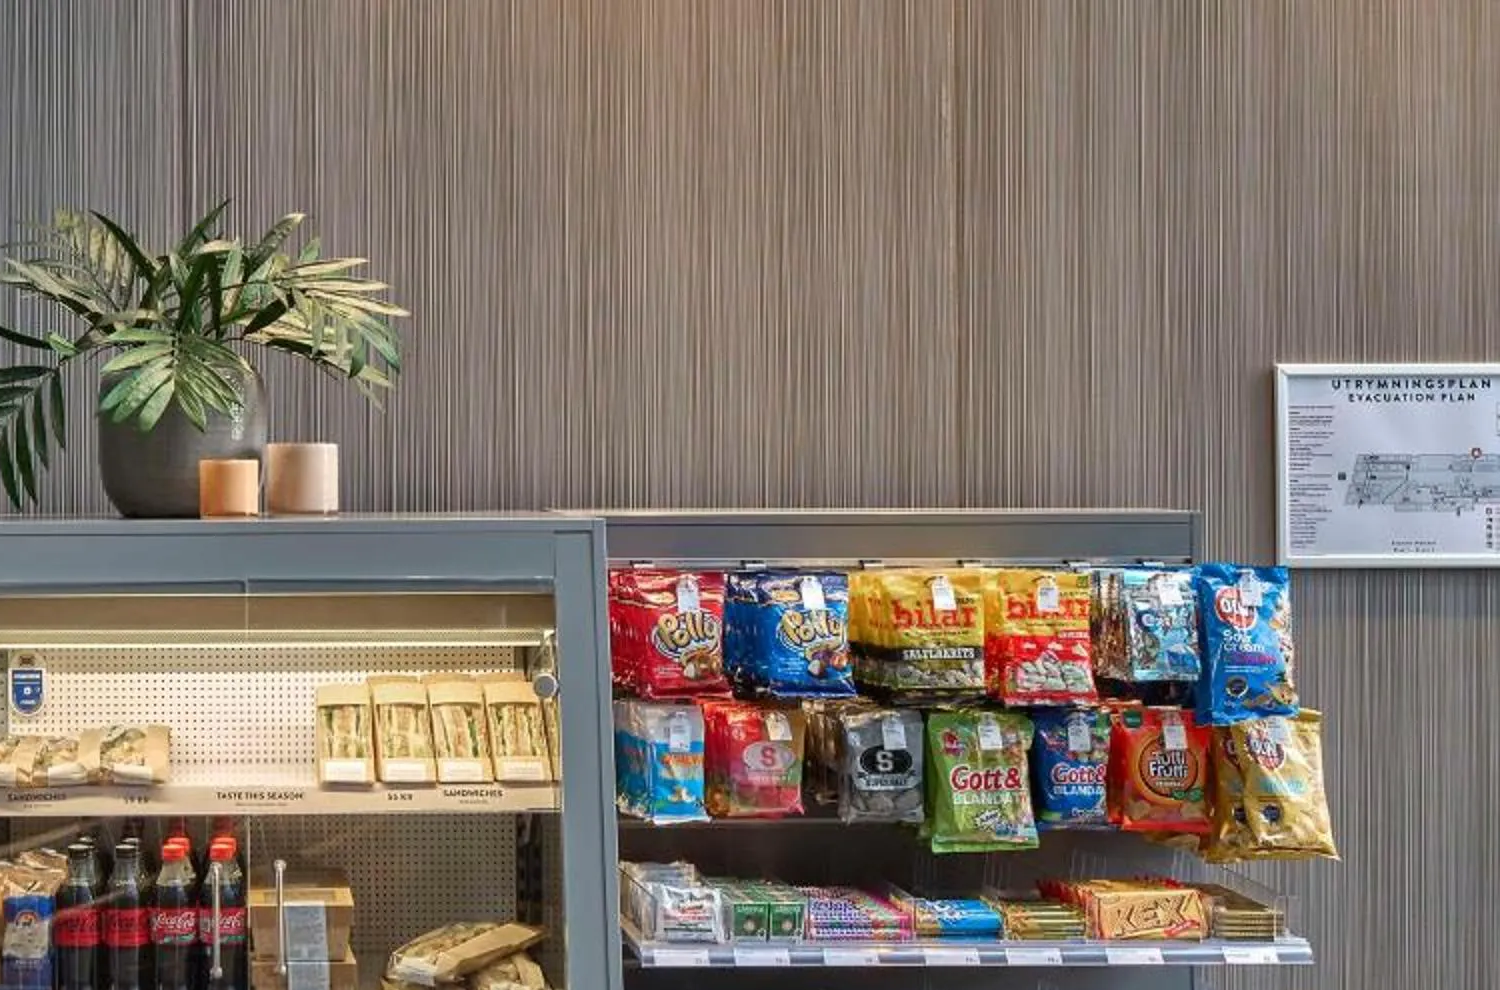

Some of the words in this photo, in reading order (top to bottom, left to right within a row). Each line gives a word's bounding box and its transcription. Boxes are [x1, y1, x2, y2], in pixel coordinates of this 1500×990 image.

[1331, 379, 1491, 390] UTRYMNINGSPLAN
[1348, 393, 1434, 403] EVACUATION
[1441, 393, 1476, 403] PLAN
[657, 610, 717, 650] Polly
